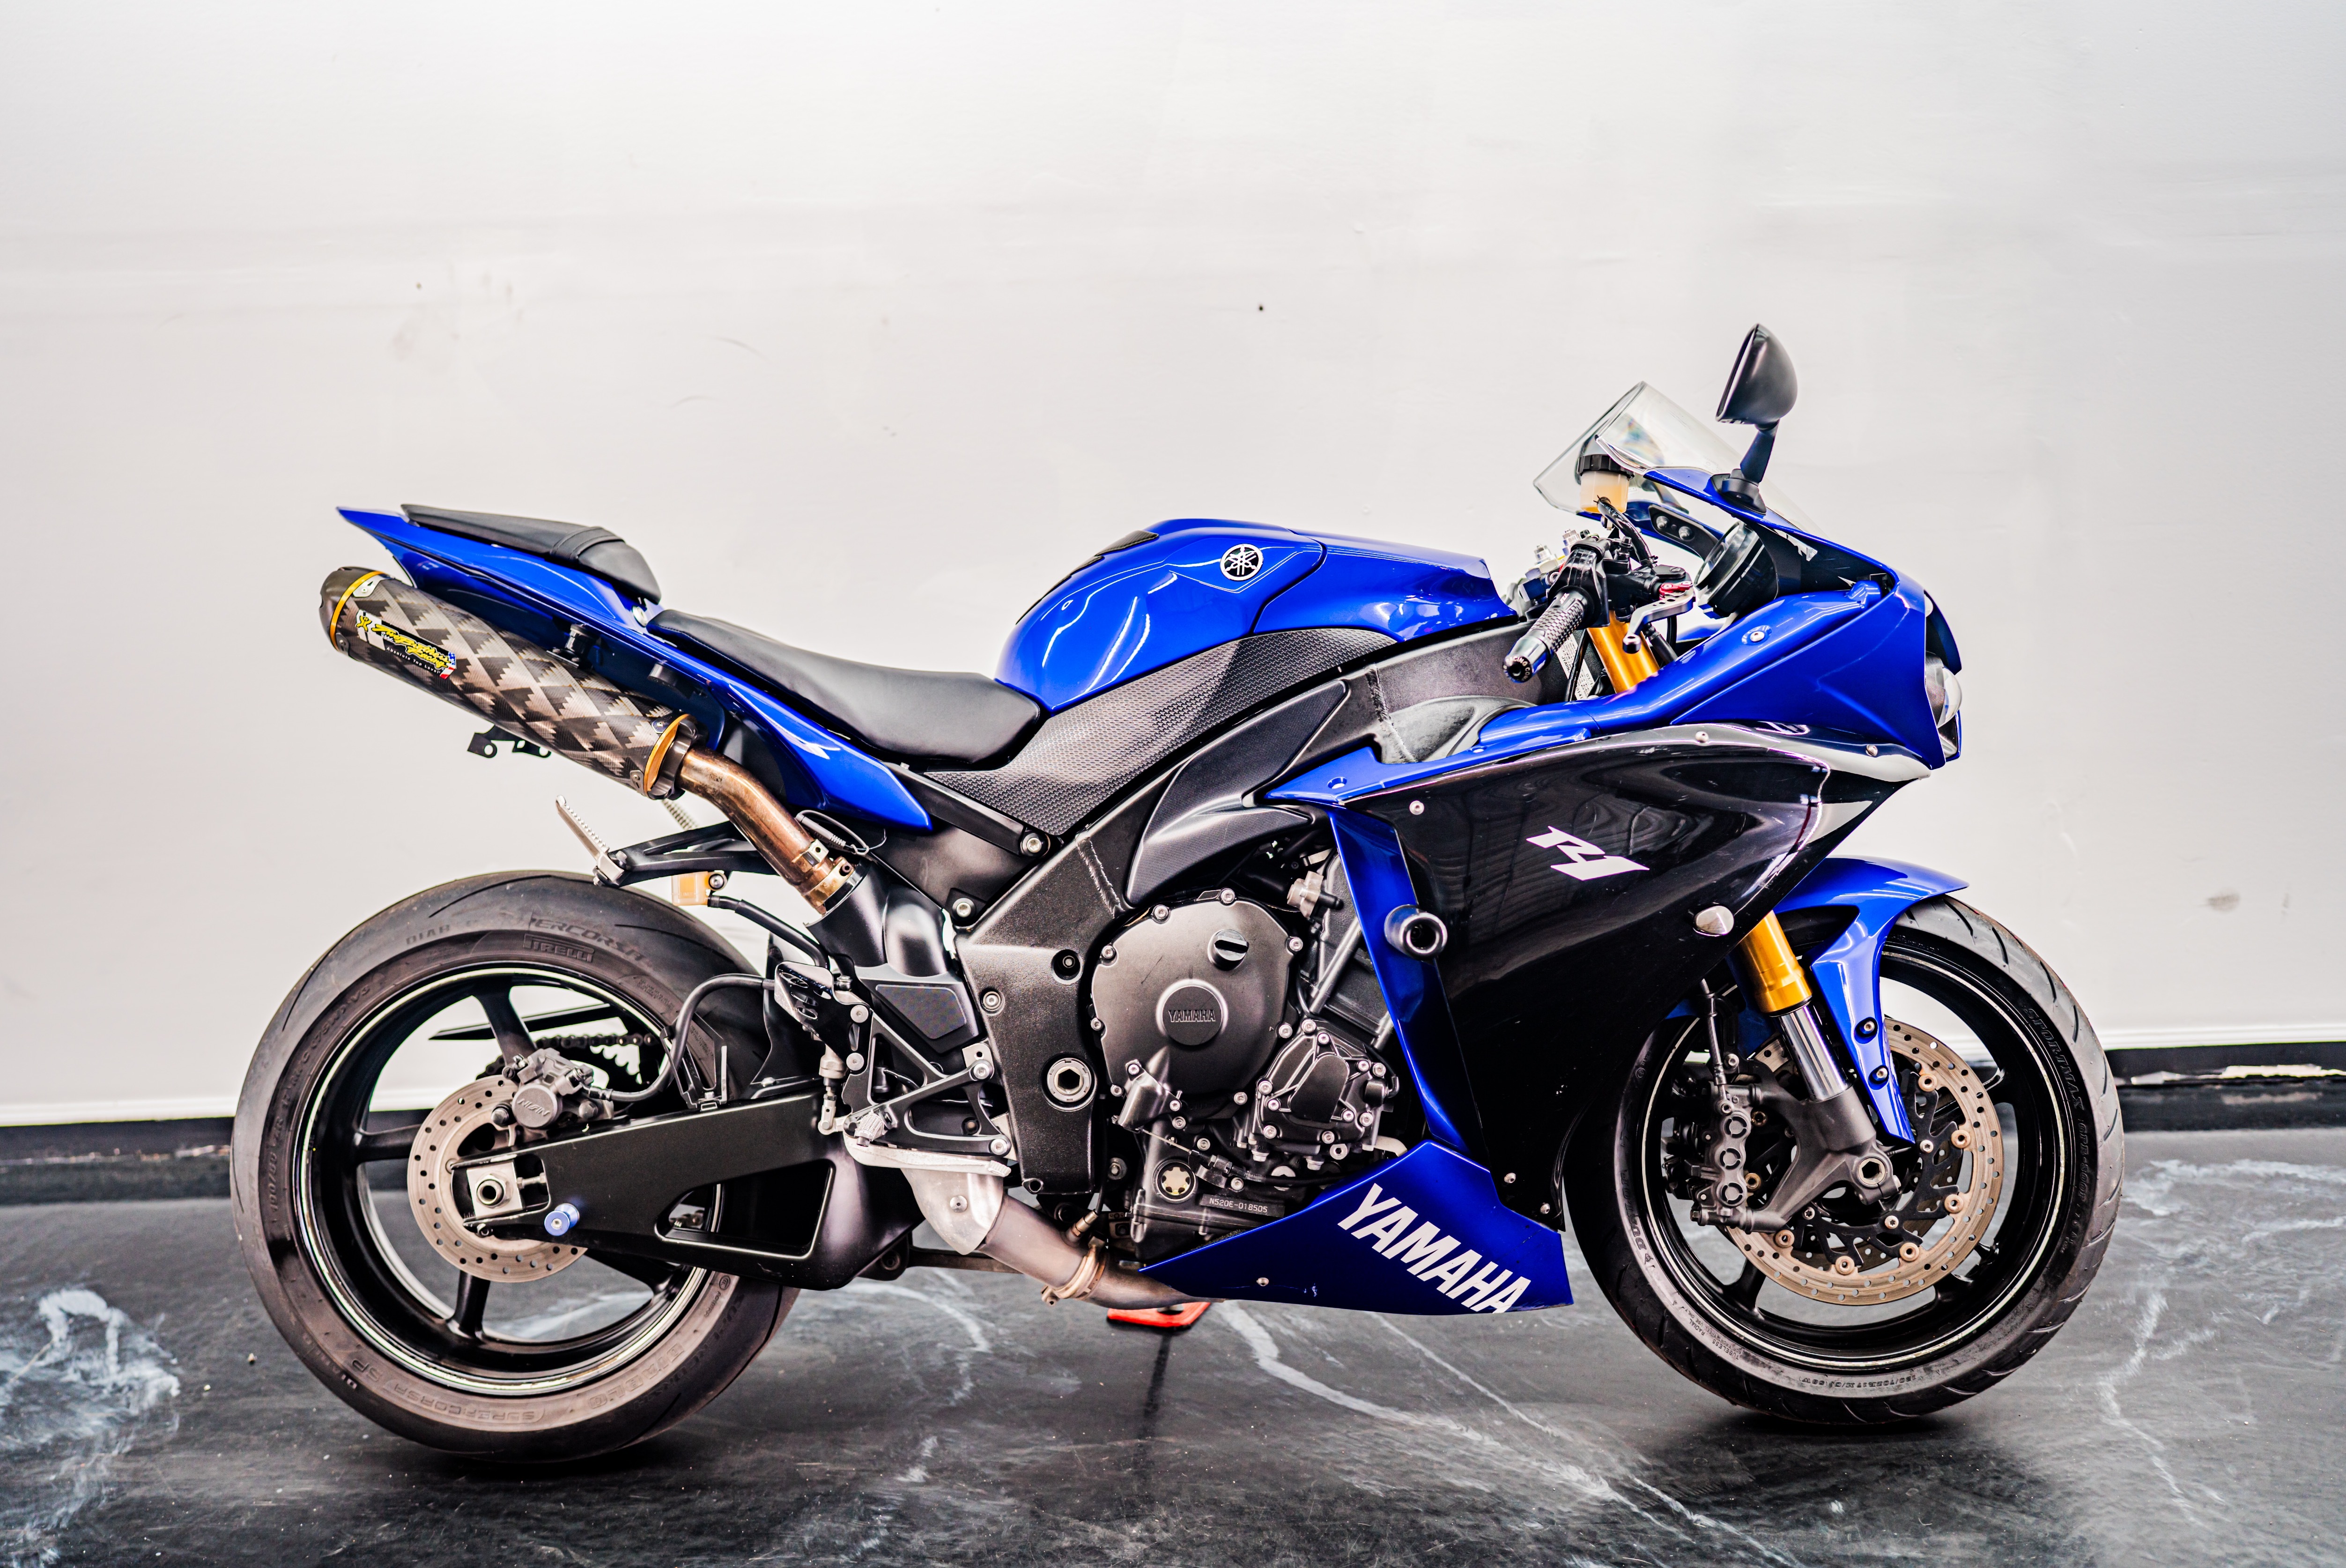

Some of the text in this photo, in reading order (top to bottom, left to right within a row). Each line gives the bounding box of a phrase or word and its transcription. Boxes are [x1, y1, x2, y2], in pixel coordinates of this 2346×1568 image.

[386, 647, 411, 661] Absolute
[523, 933, 595, 963] PIRELLI
[1168, 1009, 1216, 1022] YAMAHA
[2022, 1004, 2085, 1113] SPORTMAX
[1209, 1198, 1268, 1213] N520E-018505
[1620, 1171, 1647, 1252] DUNLOP
[1337, 1183, 1531, 1314] YAMAHA
[1684, 1307, 1695, 1319] ONLY
[1695, 1318, 1704, 1327] USE
[1687, 1317, 1741, 1360] TUBELESS RADIAL
[348, 1354, 385, 1384] SP
[585, 1340, 687, 1411] DIABLO
